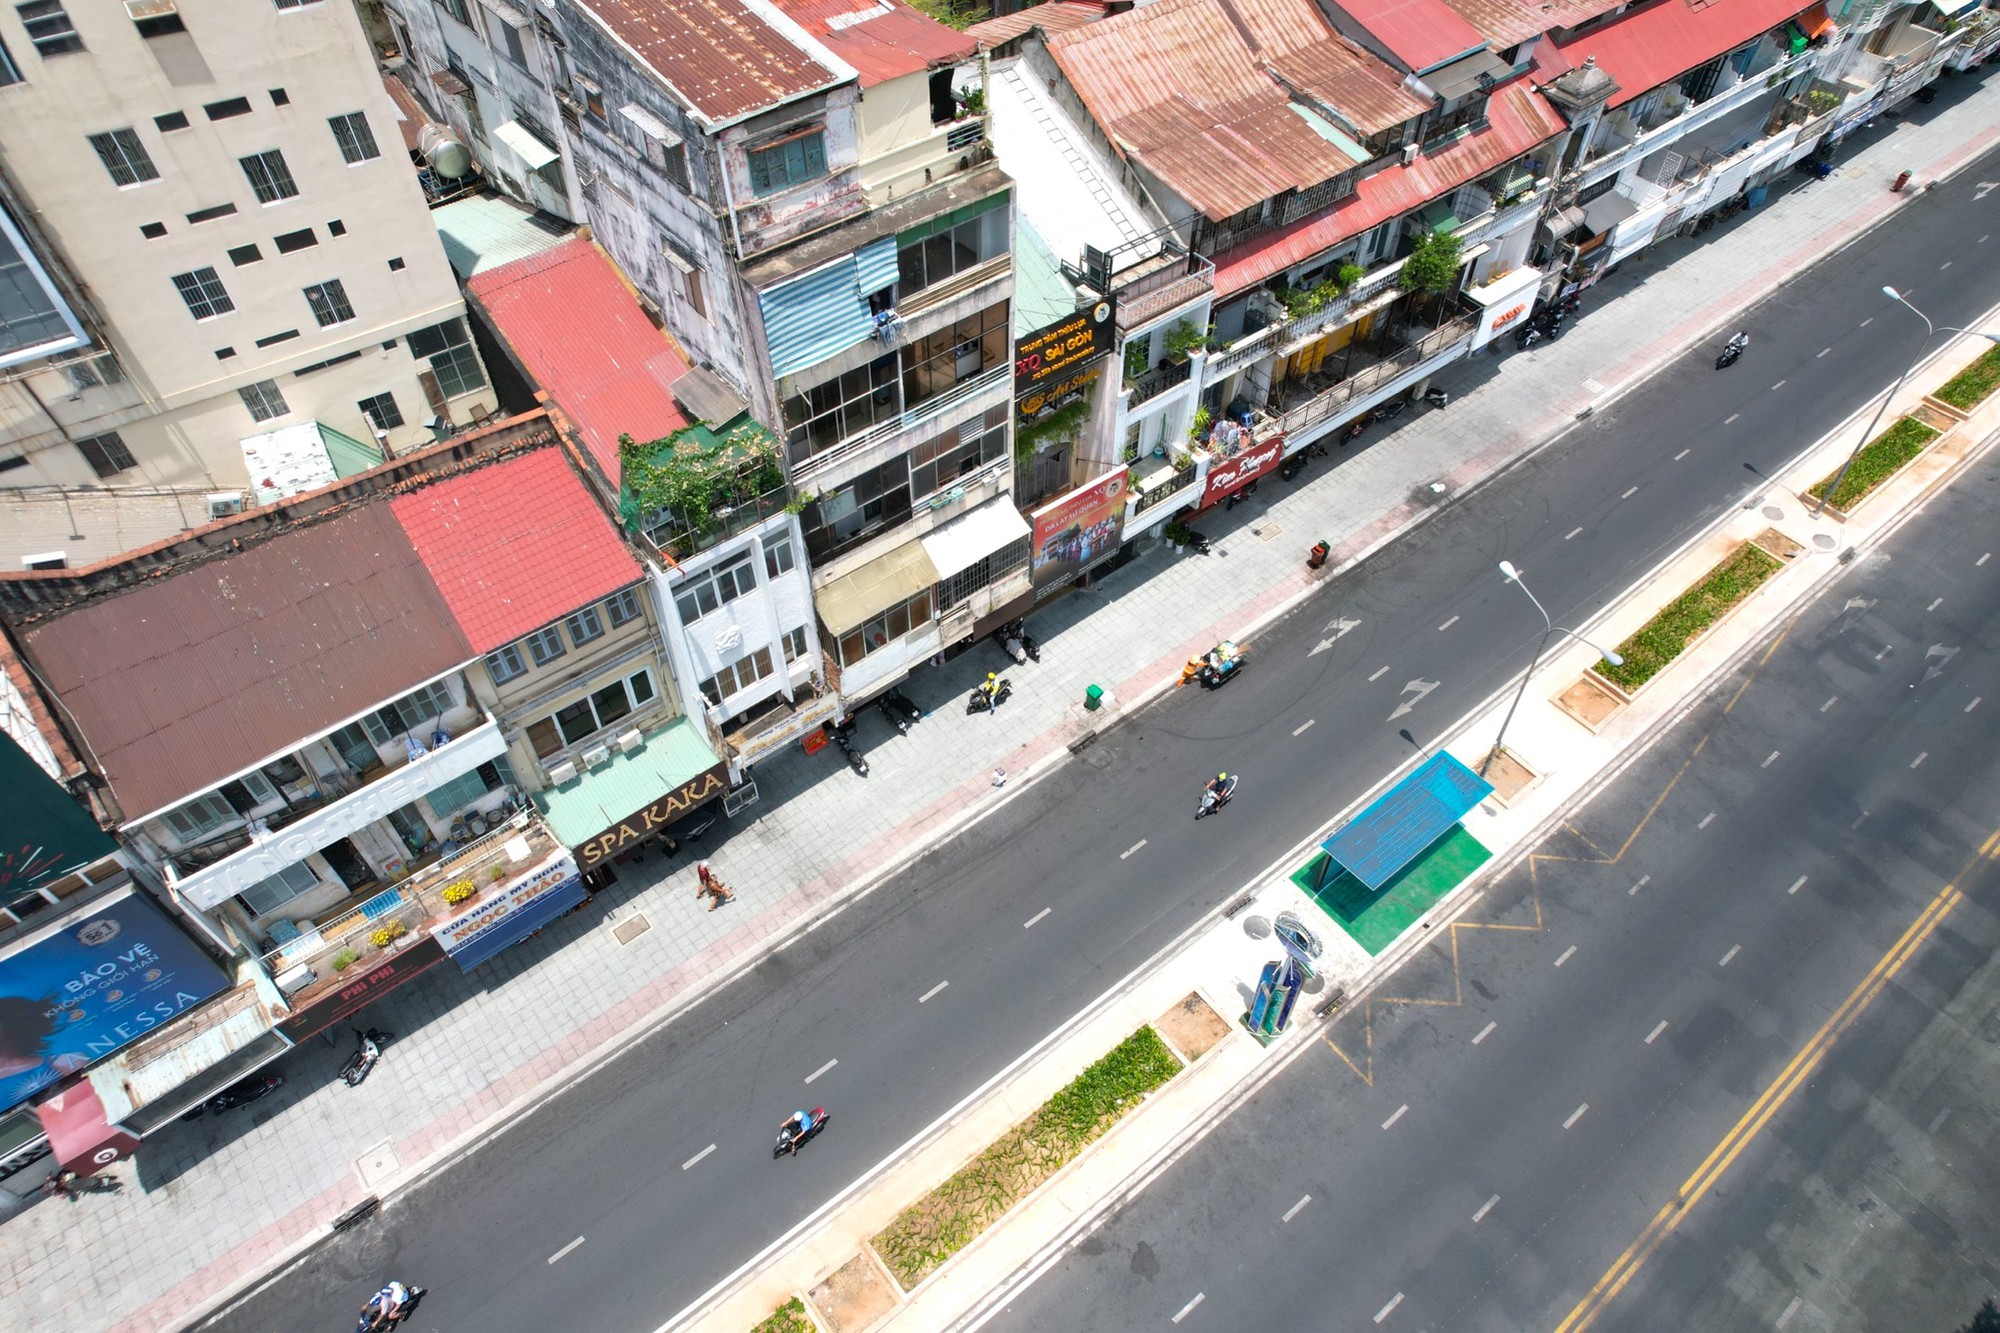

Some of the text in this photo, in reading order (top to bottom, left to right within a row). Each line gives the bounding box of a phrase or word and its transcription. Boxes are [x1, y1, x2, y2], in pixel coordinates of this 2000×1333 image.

[1016, 354, 1041, 376] XQ
[1045, 343, 1065, 361] SÀI
[1066, 329, 1093, 351] GÒN
[1211, 471, 1236, 491] Kim
[583, 773, 724, 864] SPA KAKA
[442, 917, 469, 936] CỬA
[452, 905, 510, 942] NGỌC
[118, 942, 152, 963] VỆ
[130, 953, 160, 972] HẠN
[65, 991, 200, 1070] ANESSA
